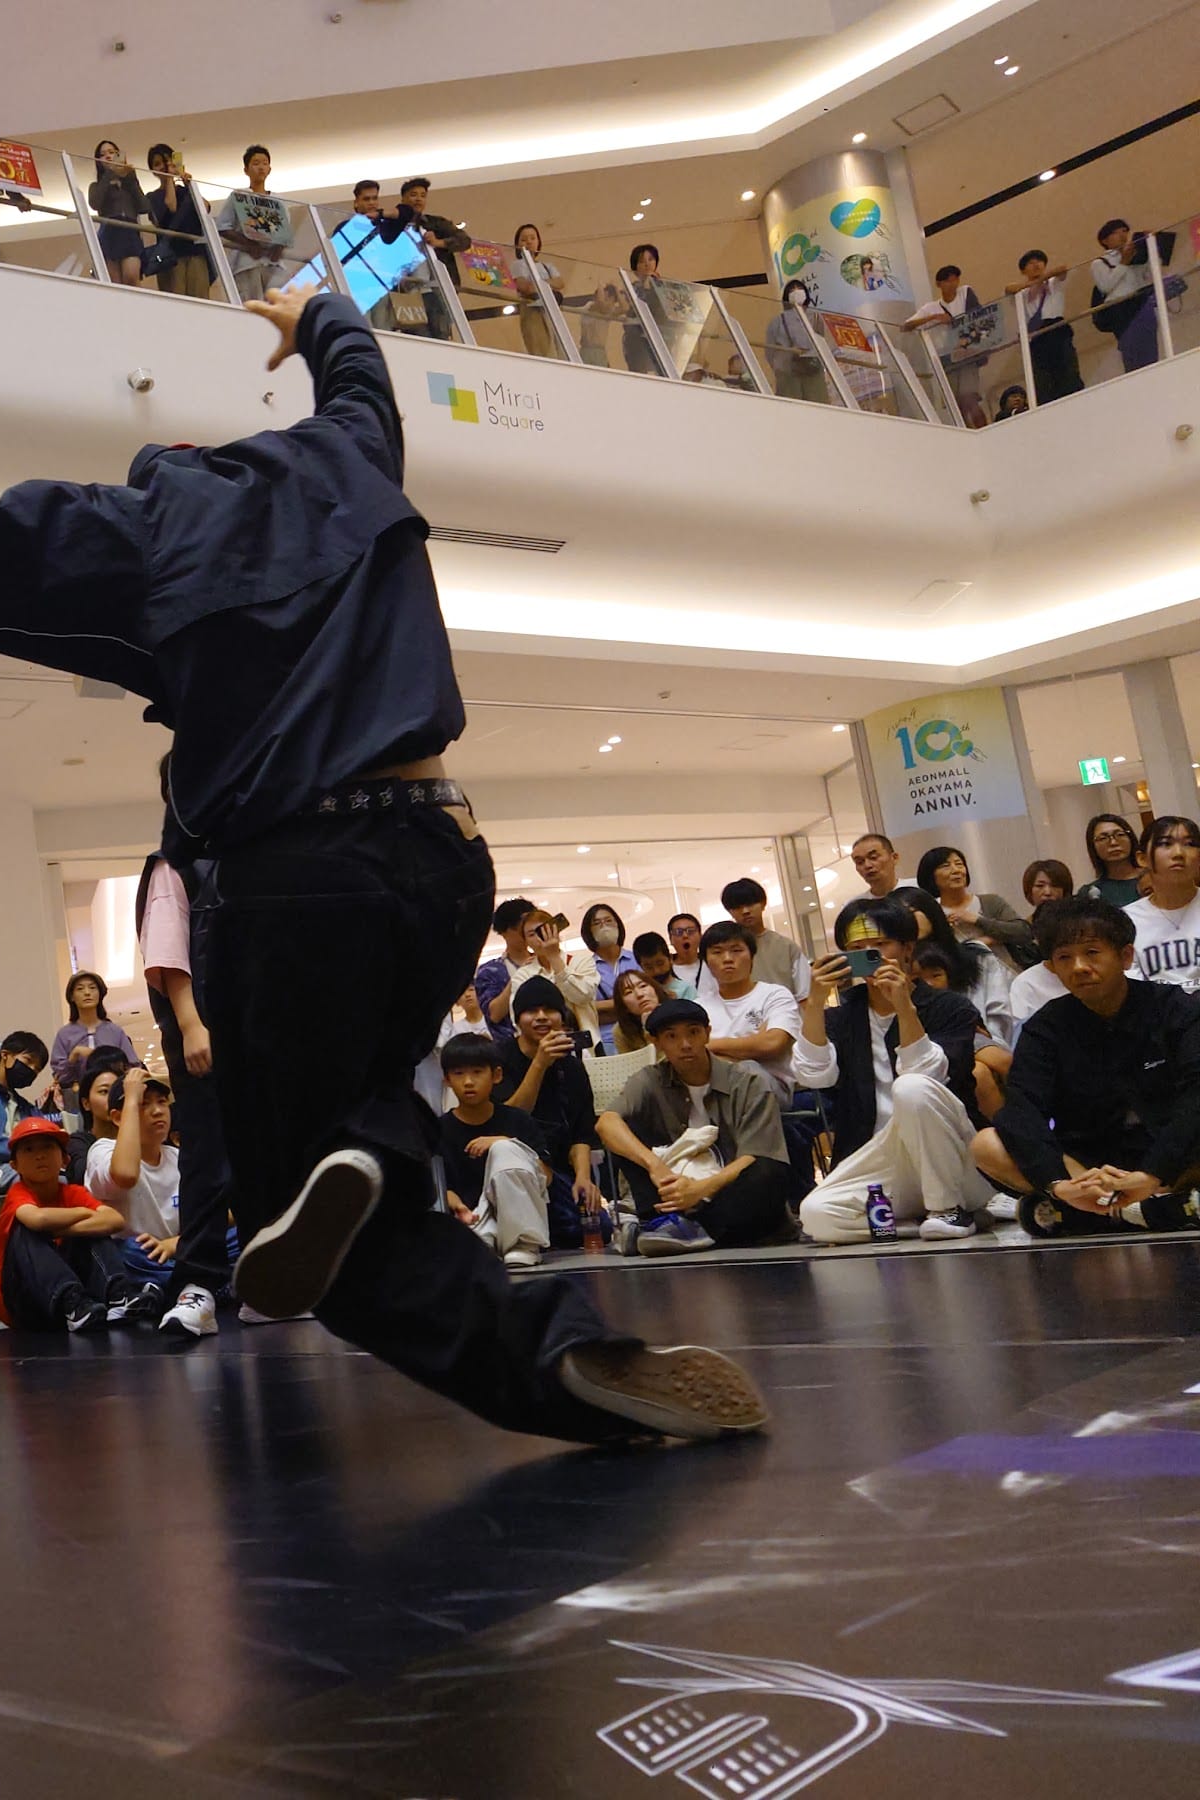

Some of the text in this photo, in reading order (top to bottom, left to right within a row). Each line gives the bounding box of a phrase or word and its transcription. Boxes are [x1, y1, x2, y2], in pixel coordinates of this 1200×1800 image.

[483, 379, 542, 411] Mirai
[487, 405, 545, 432] Square
[908, 767, 970, 787] AEONMALL
[910, 779, 973, 799] OKAYAMA
[914, 793, 977, 815] ANNIV.
